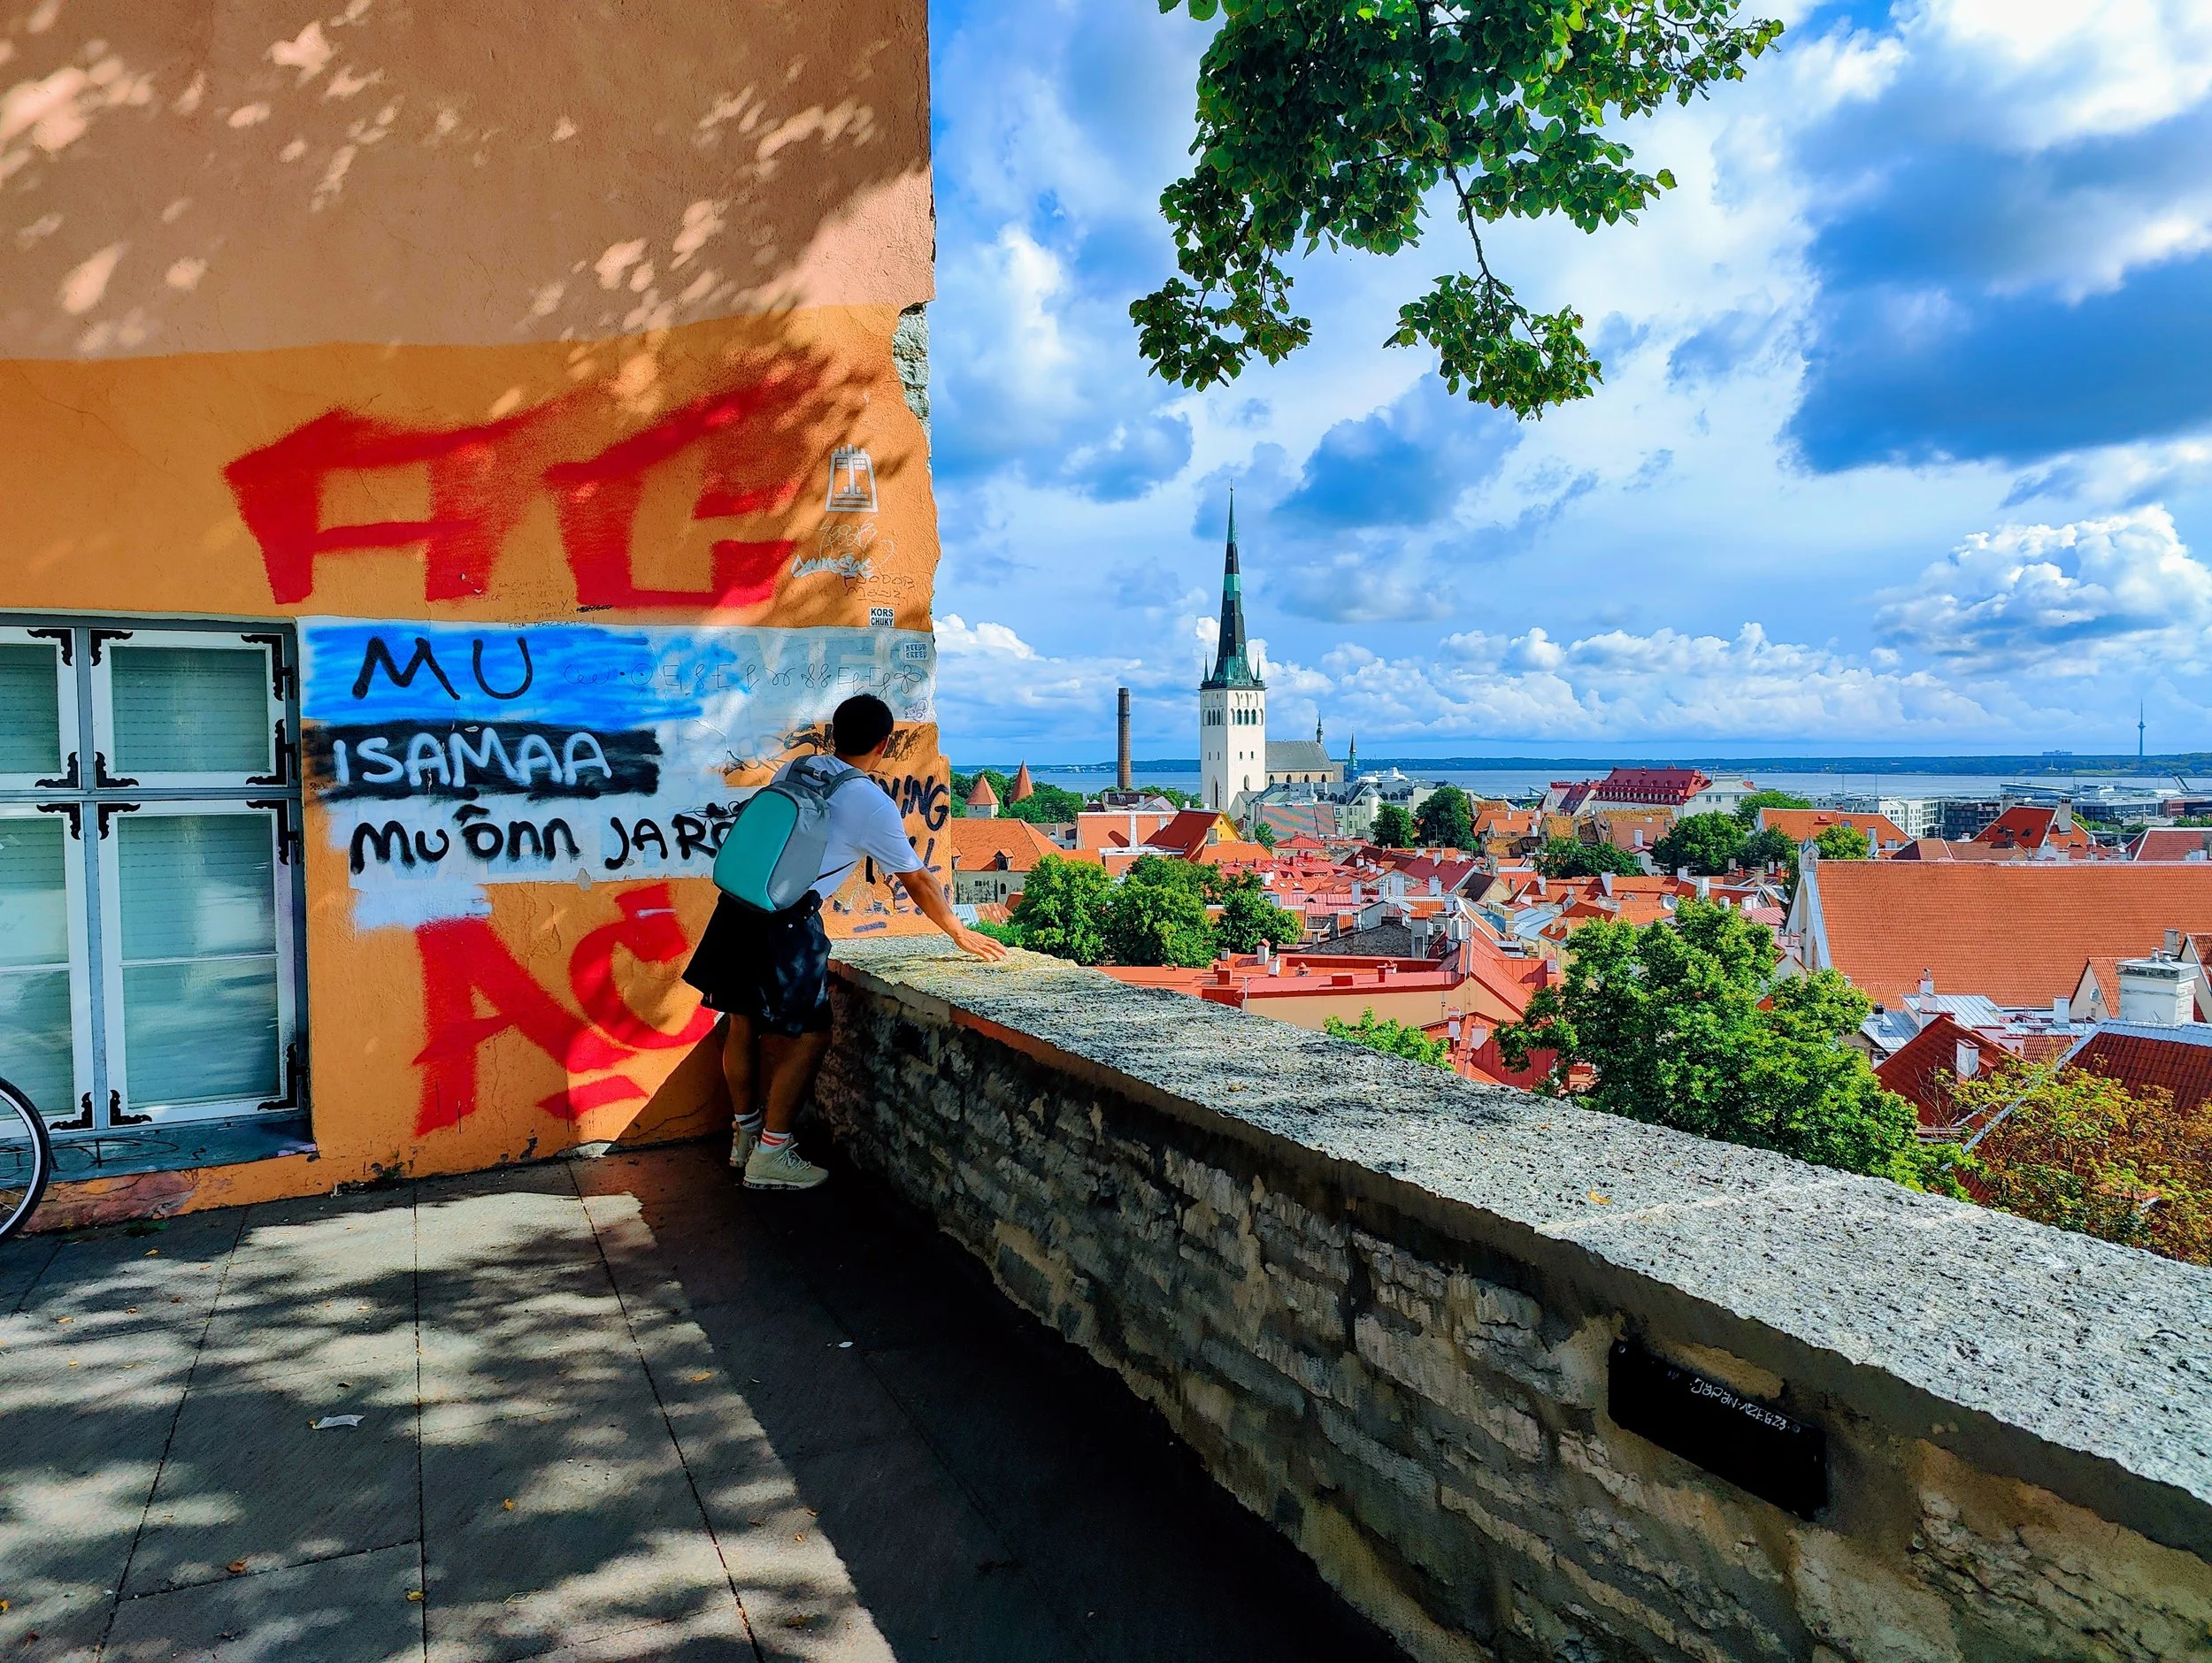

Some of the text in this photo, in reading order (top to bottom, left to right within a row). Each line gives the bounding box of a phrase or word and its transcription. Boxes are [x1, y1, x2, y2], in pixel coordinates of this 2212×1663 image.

[871, 608, 894, 617] KORS
[871, 617, 894, 626] CHUKY
[352, 636, 533, 700] MU
[333, 726, 611, 788] ISAMAA
